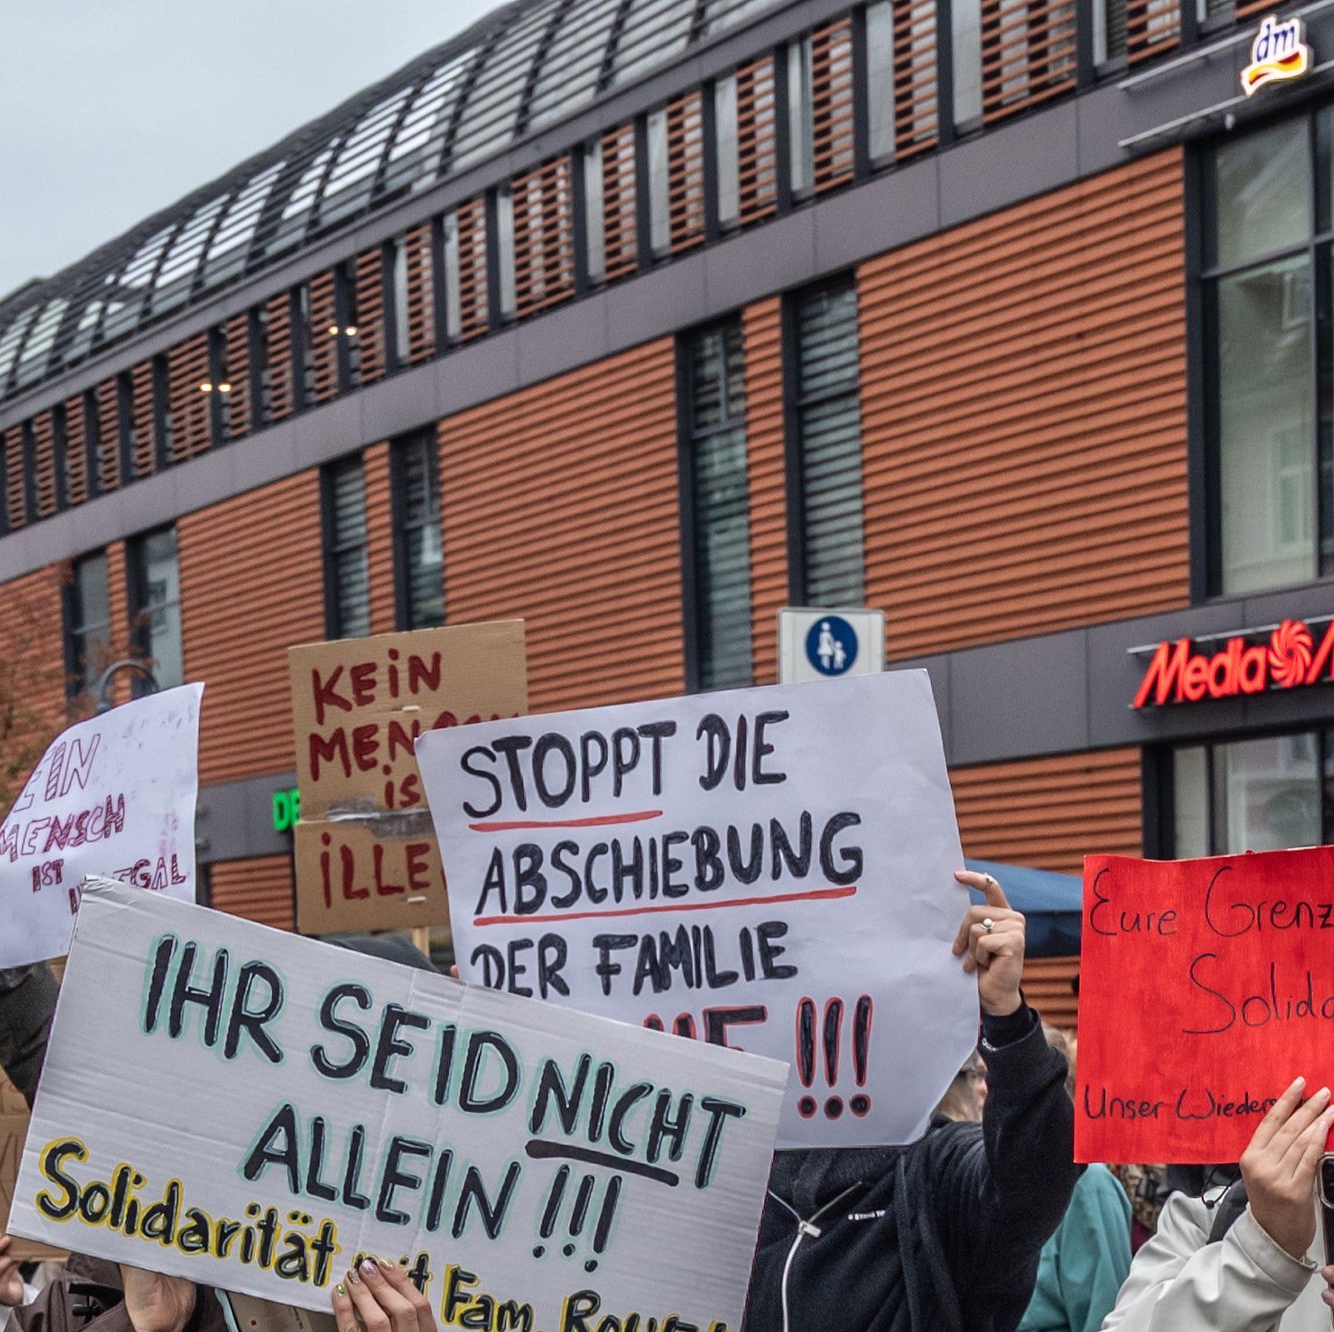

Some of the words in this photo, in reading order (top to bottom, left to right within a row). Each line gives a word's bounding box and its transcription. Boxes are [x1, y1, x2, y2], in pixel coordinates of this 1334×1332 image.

[1256, 24, 1295, 62] dm
[1133, 637, 1268, 708] Media
[461, 720, 677, 818] STOPPT
[695, 710, 791, 791] DIE
[32, 859, 64, 893] IST
[475, 810, 864, 915] ABSCHIEBUNG
[1090, 867, 1178, 937] Eure
[470, 932, 570, 998] DER
[593, 921, 799, 997] FAMILIE
[141, 934, 285, 1065] IHR
[312, 982, 520, 1115] SEID
[528, 1053, 746, 1190] NICHT
[1083, 1084, 1161, 1121] Unser
[242, 1102, 521, 1240] ALLEIN
[37, 1139, 336, 1288] Solidarität
